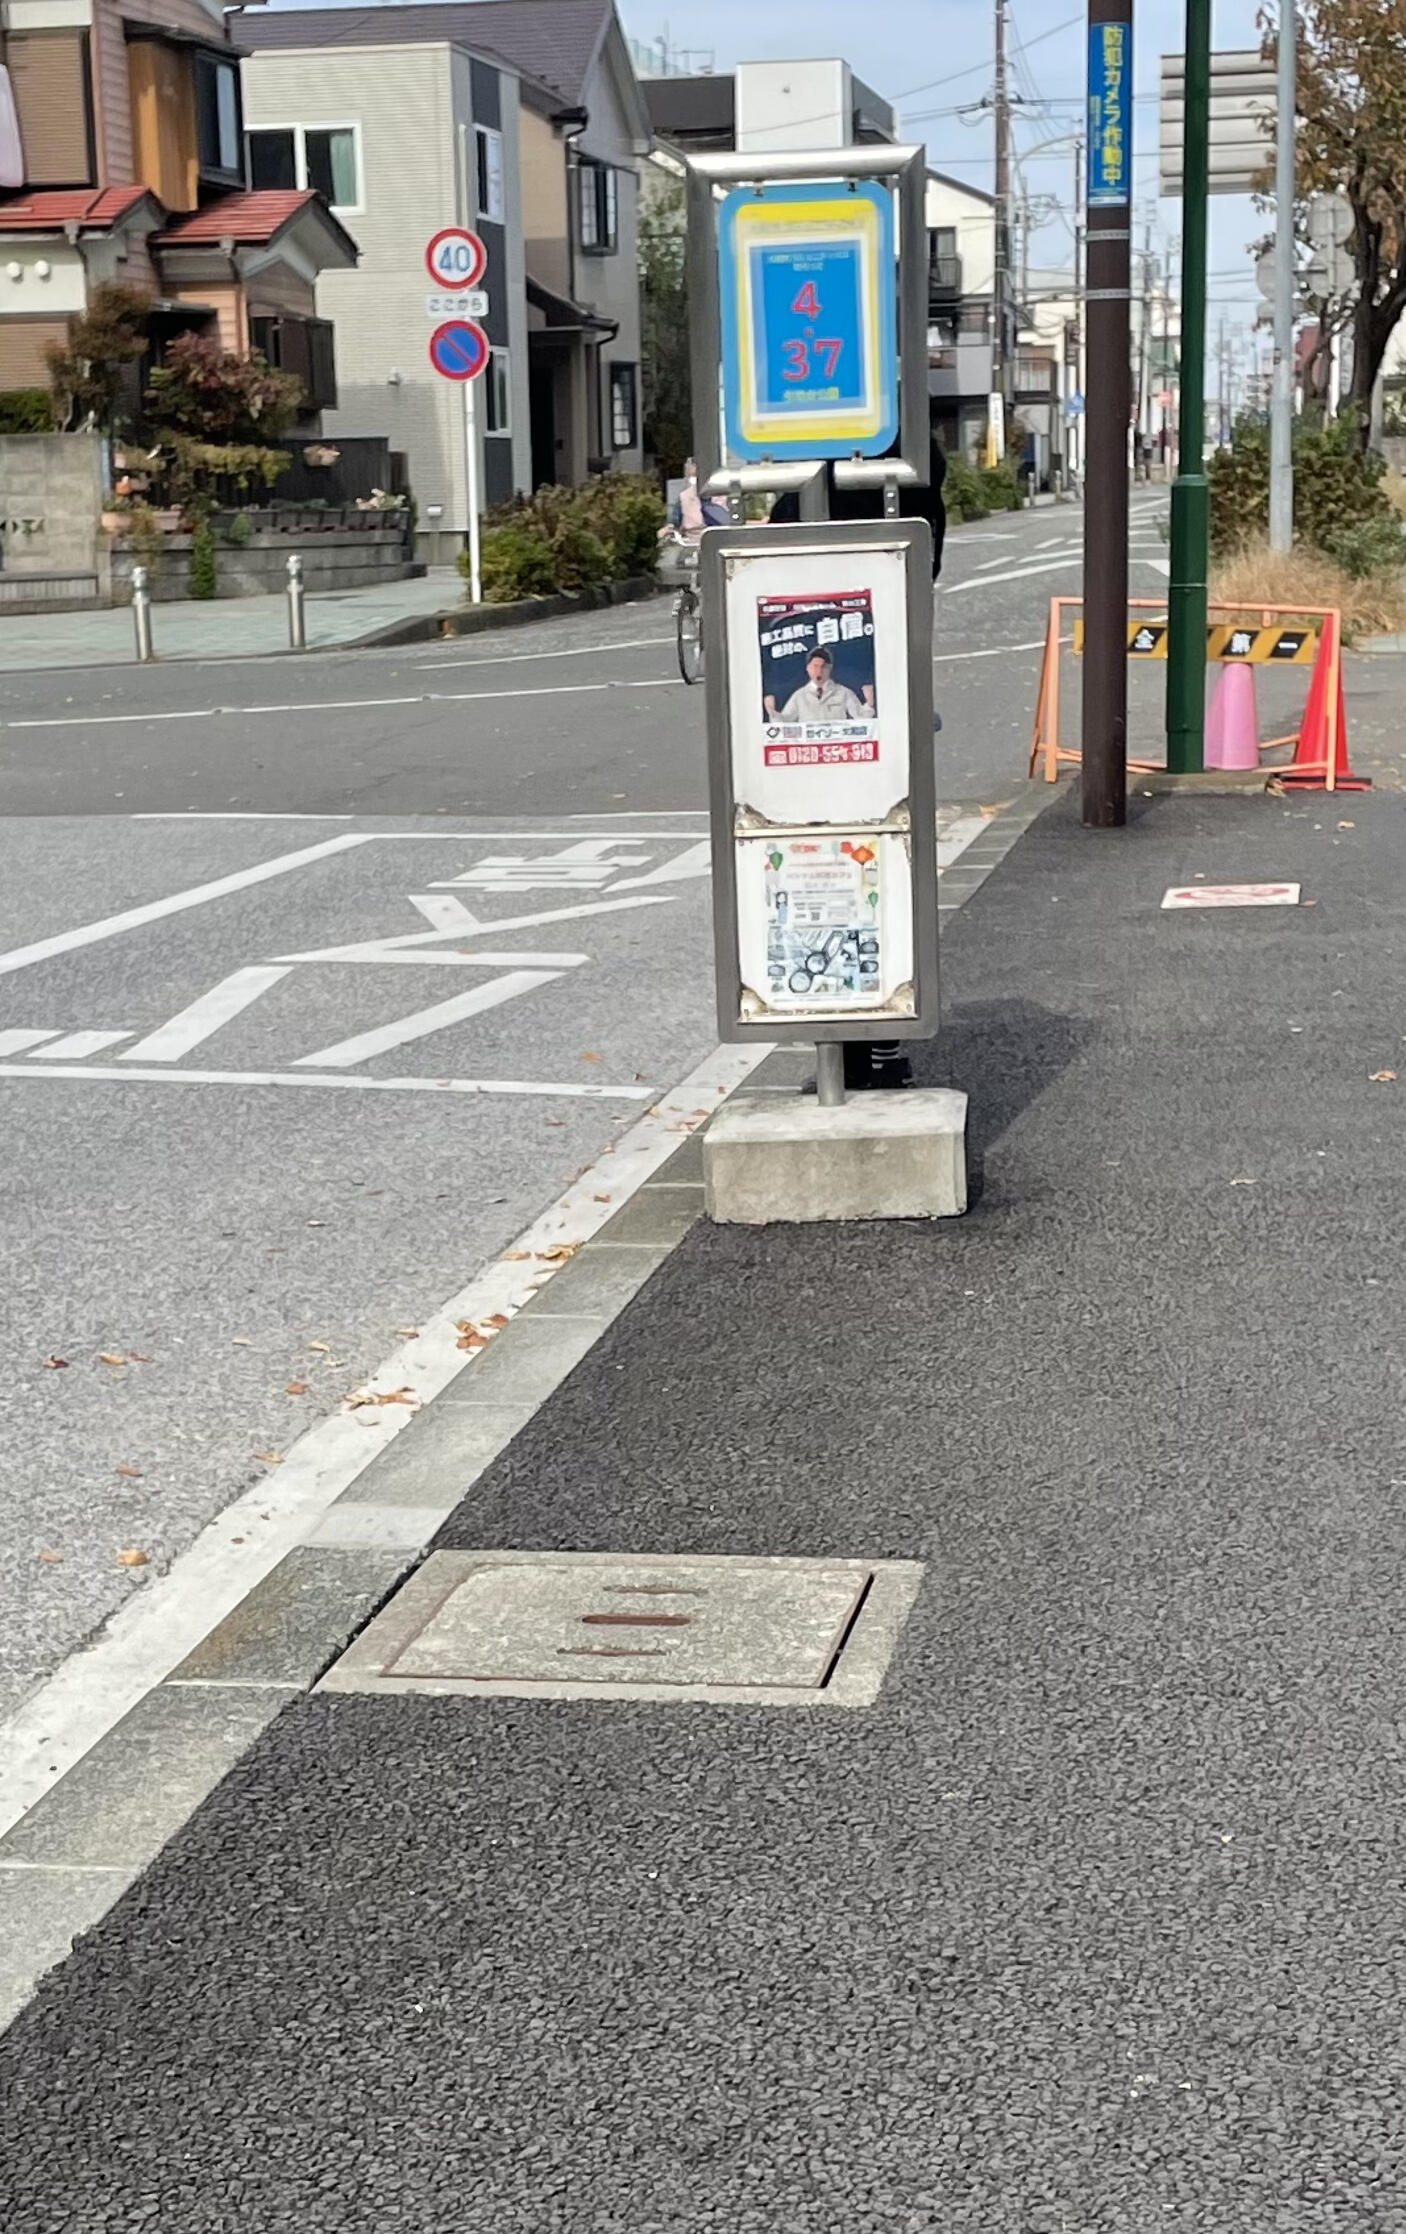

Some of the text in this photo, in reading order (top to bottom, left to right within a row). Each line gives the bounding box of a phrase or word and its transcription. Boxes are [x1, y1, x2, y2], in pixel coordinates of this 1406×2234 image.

[1103, 25, 1123, 186] 防犯カメラ作動中
[439, 246, 471, 272] 40
[429, 298, 483, 312] ここから
[791, 280, 822, 321] 4
[782, 338, 842, 381] 37
